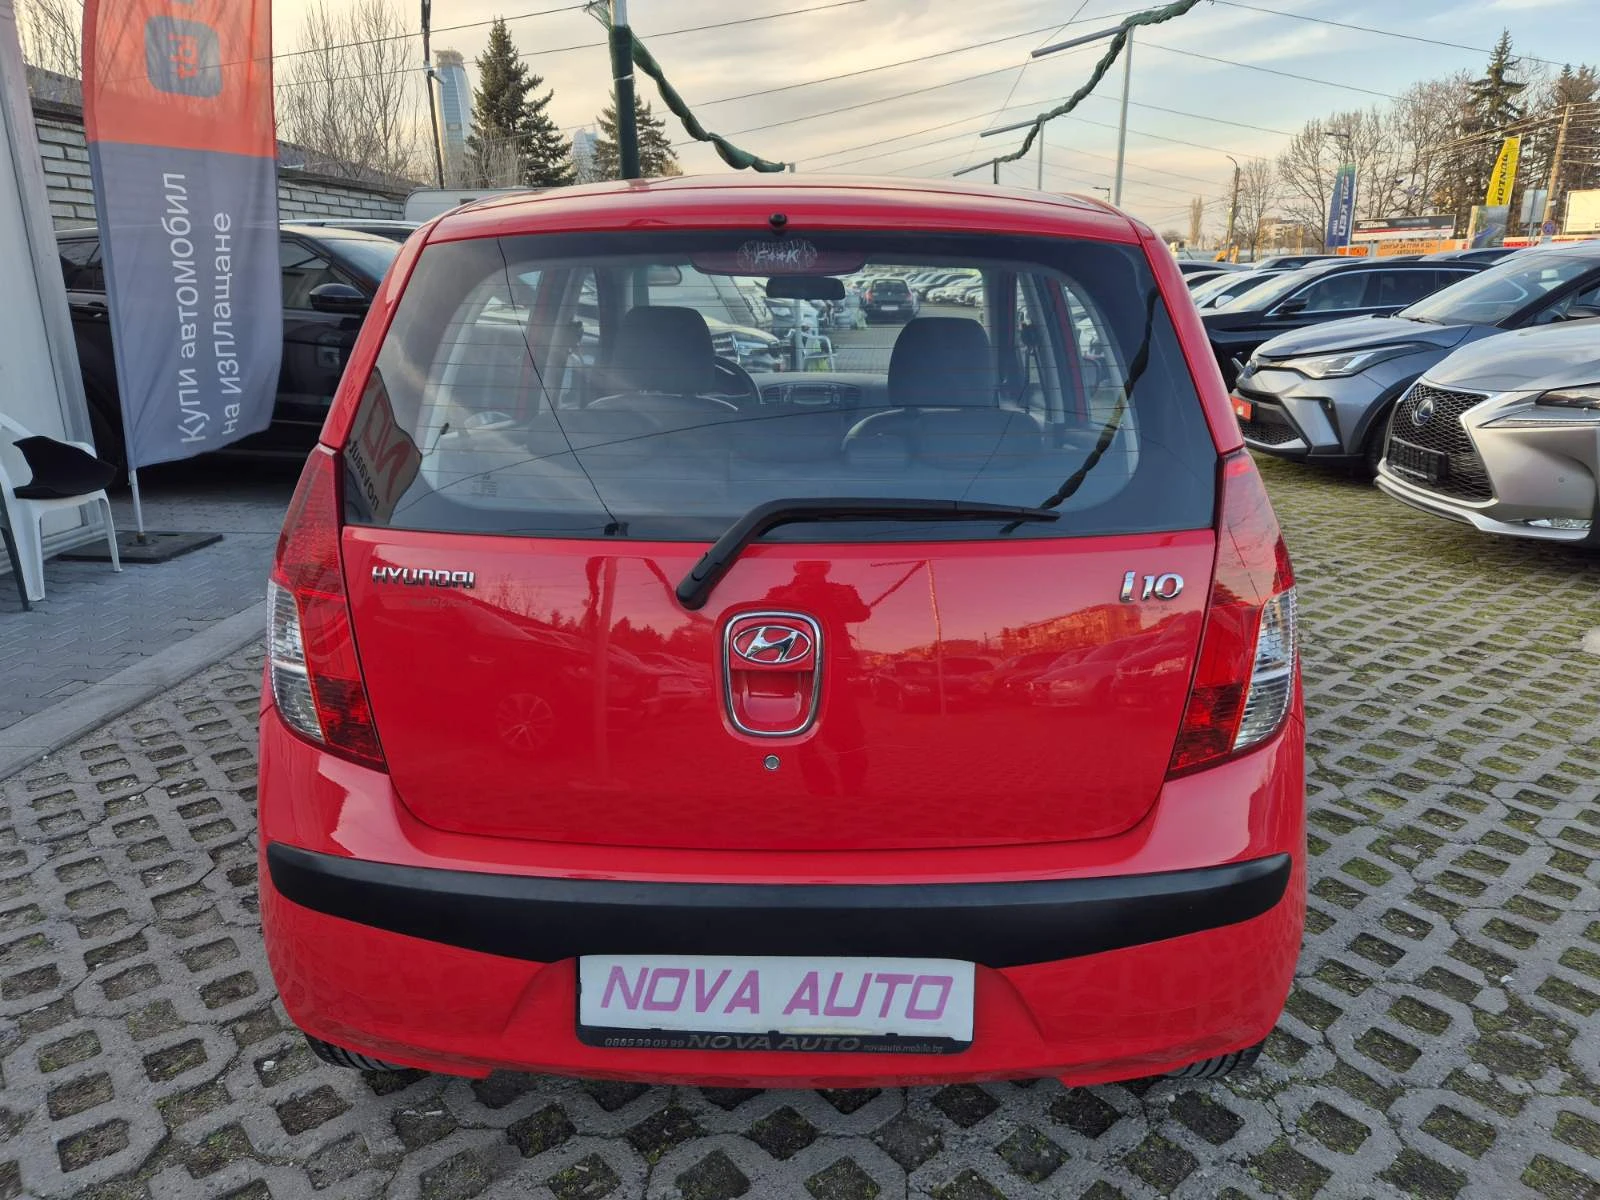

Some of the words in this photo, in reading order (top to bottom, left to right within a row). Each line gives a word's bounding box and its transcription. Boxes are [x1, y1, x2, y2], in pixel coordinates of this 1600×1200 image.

[1497, 154, 1508, 205] DUNLOP
[161, 172, 199, 359] автомобил
[212, 212, 243, 395] изплащане
[177, 368, 210, 443] Купи
[222, 402, 241, 435] на
[371, 566, 476, 589] HYUNDAI
[600, 965, 760, 1015] NOVA
[783, 970, 954, 1020] AUTO
[688, 1034, 771, 1050] NOVA
[777, 1037, 860, 1051] AUTO
